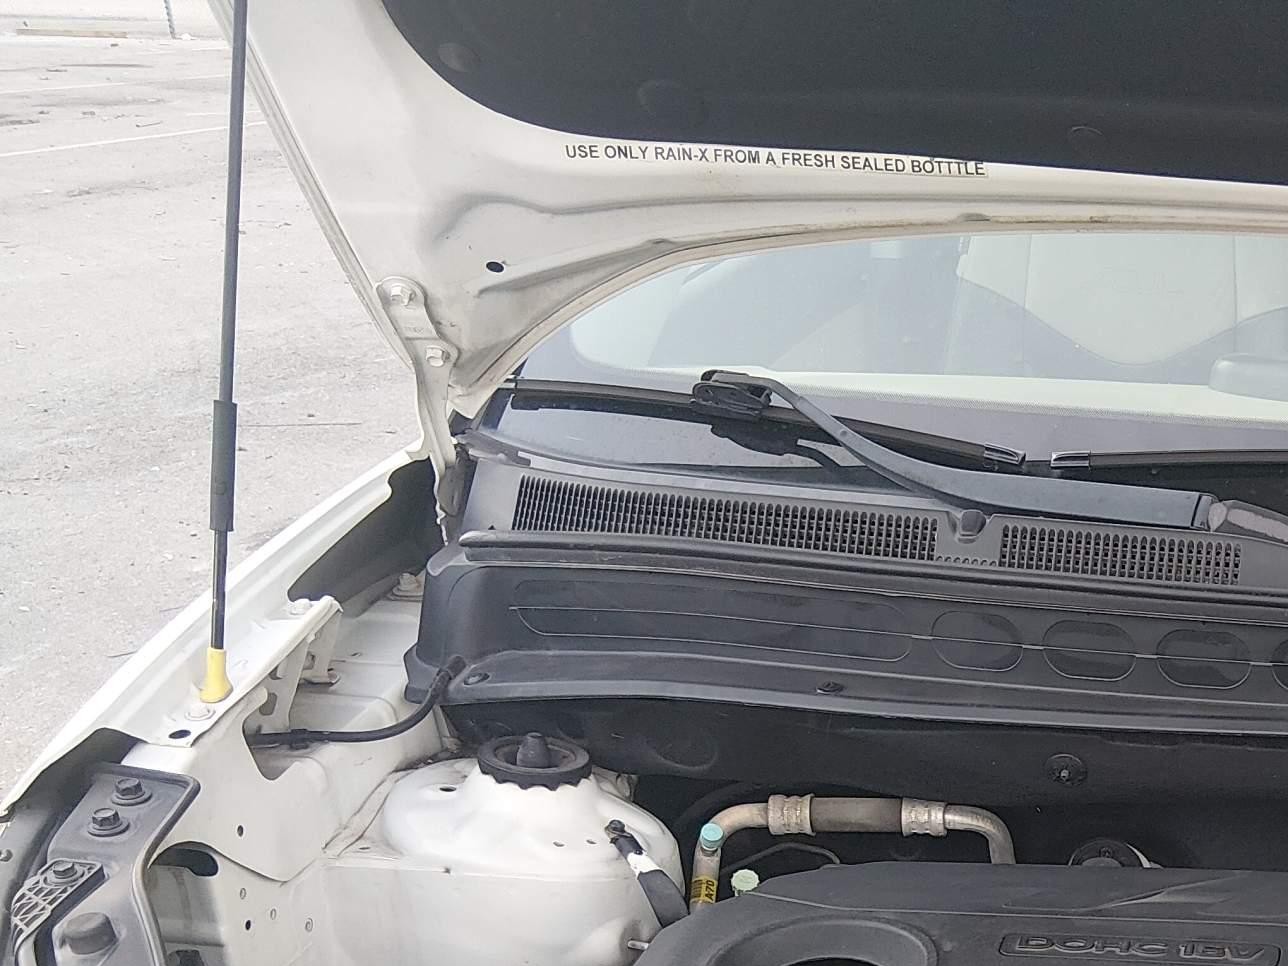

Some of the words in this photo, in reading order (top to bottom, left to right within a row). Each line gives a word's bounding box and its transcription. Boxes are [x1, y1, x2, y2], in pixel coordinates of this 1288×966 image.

[565, 144, 600, 159] USE
[604, 145, 649, 160] ONLY
[654, 146, 709, 162] RAIN-X
[714, 149, 760, 164] FROM
[765, 151, 777, 165] A
[781, 152, 836, 169] FRESH
[841, 155, 905, 173] SEALED
[911, 160, 986, 176] BOTTTLE
[1016, 935, 1169, 957] DOHC
[1179, 941, 1265, 961] 16V
